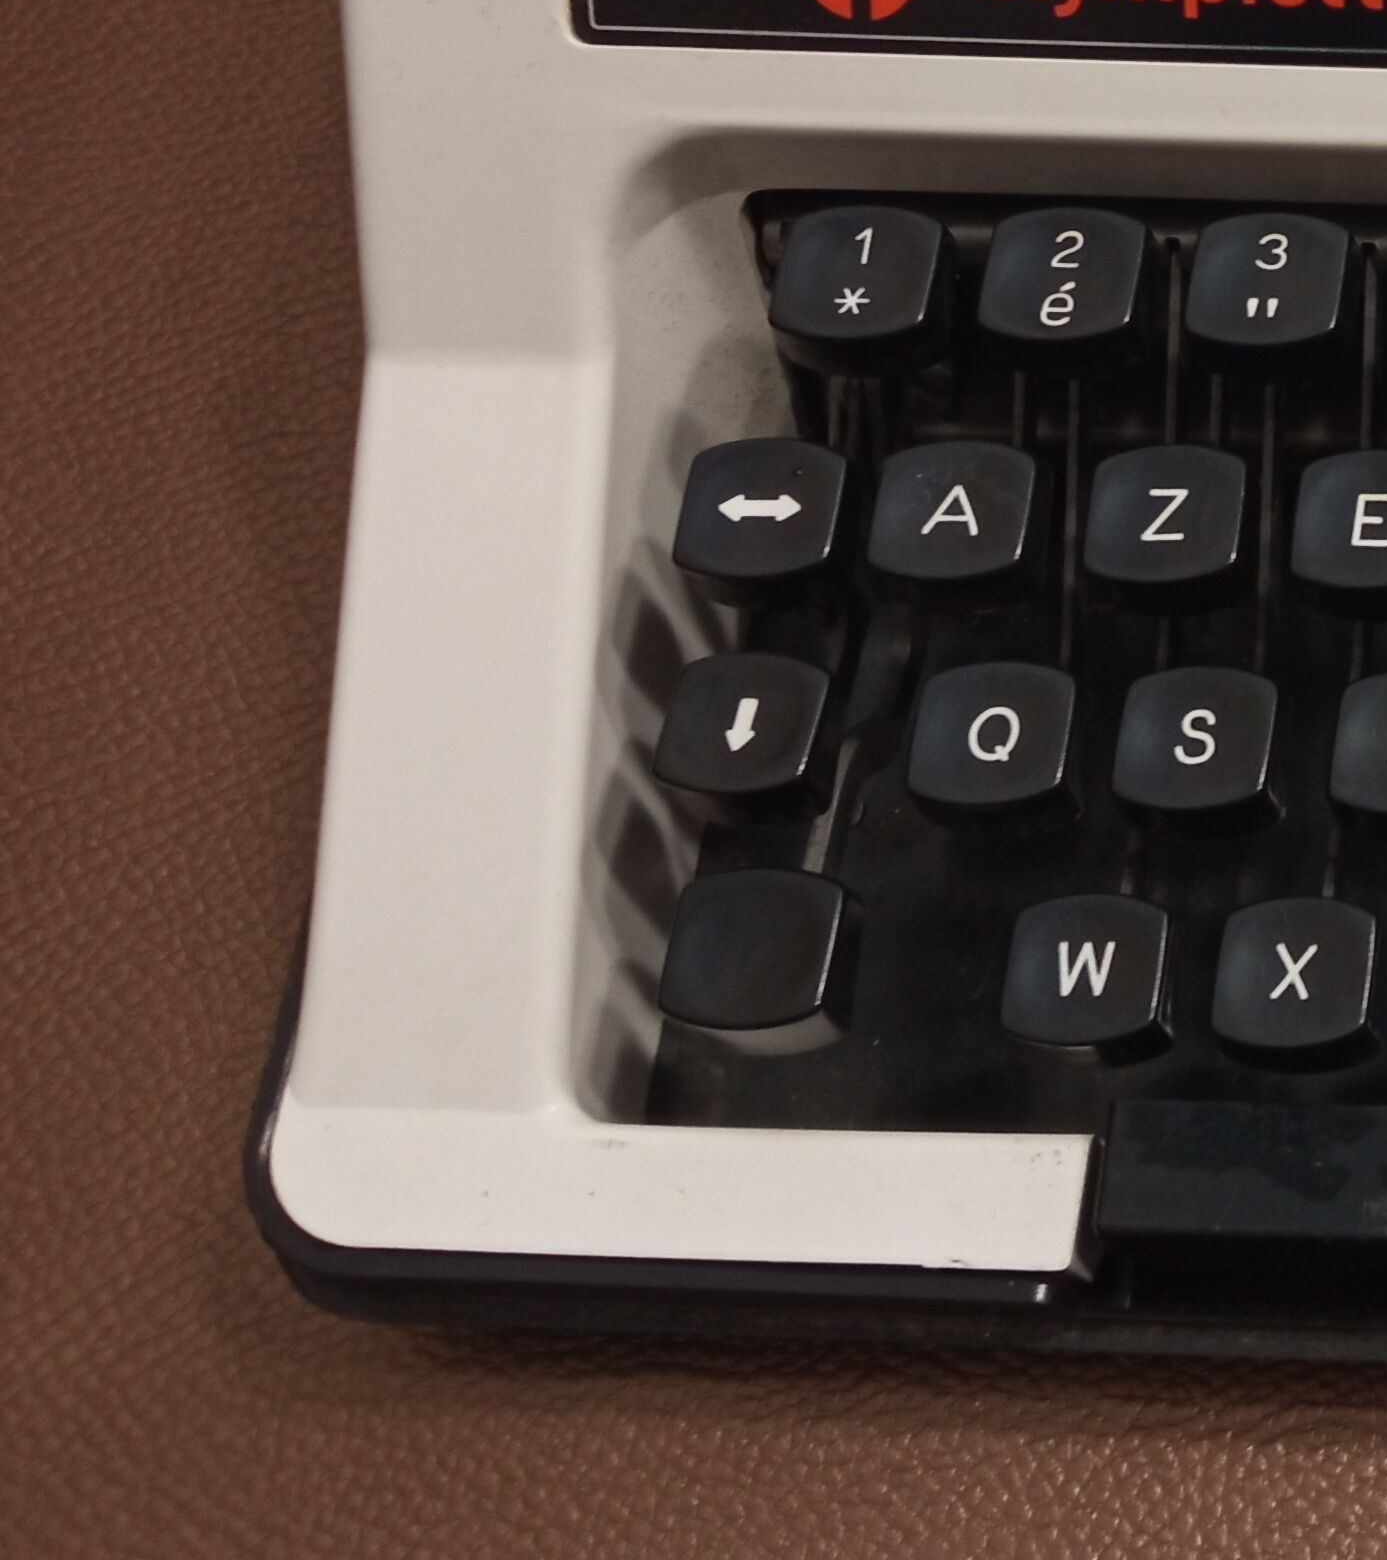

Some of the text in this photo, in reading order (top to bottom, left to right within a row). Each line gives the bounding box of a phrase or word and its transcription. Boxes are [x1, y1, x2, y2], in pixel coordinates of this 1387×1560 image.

[857, 229, 872, 263] 1
[1052, 231, 1083, 267] 2
[1256, 234, 1287, 269] 3
[1041, 282, 1075, 325] é
[922, 486, 977, 535] A
[1142, 489, 1188, 540] Z
[969, 707, 1019, 761] Q
[1175, 710, 1215, 764] S
[1060, 942, 1114, 996] W
[1271, 944, 1317, 999] X
